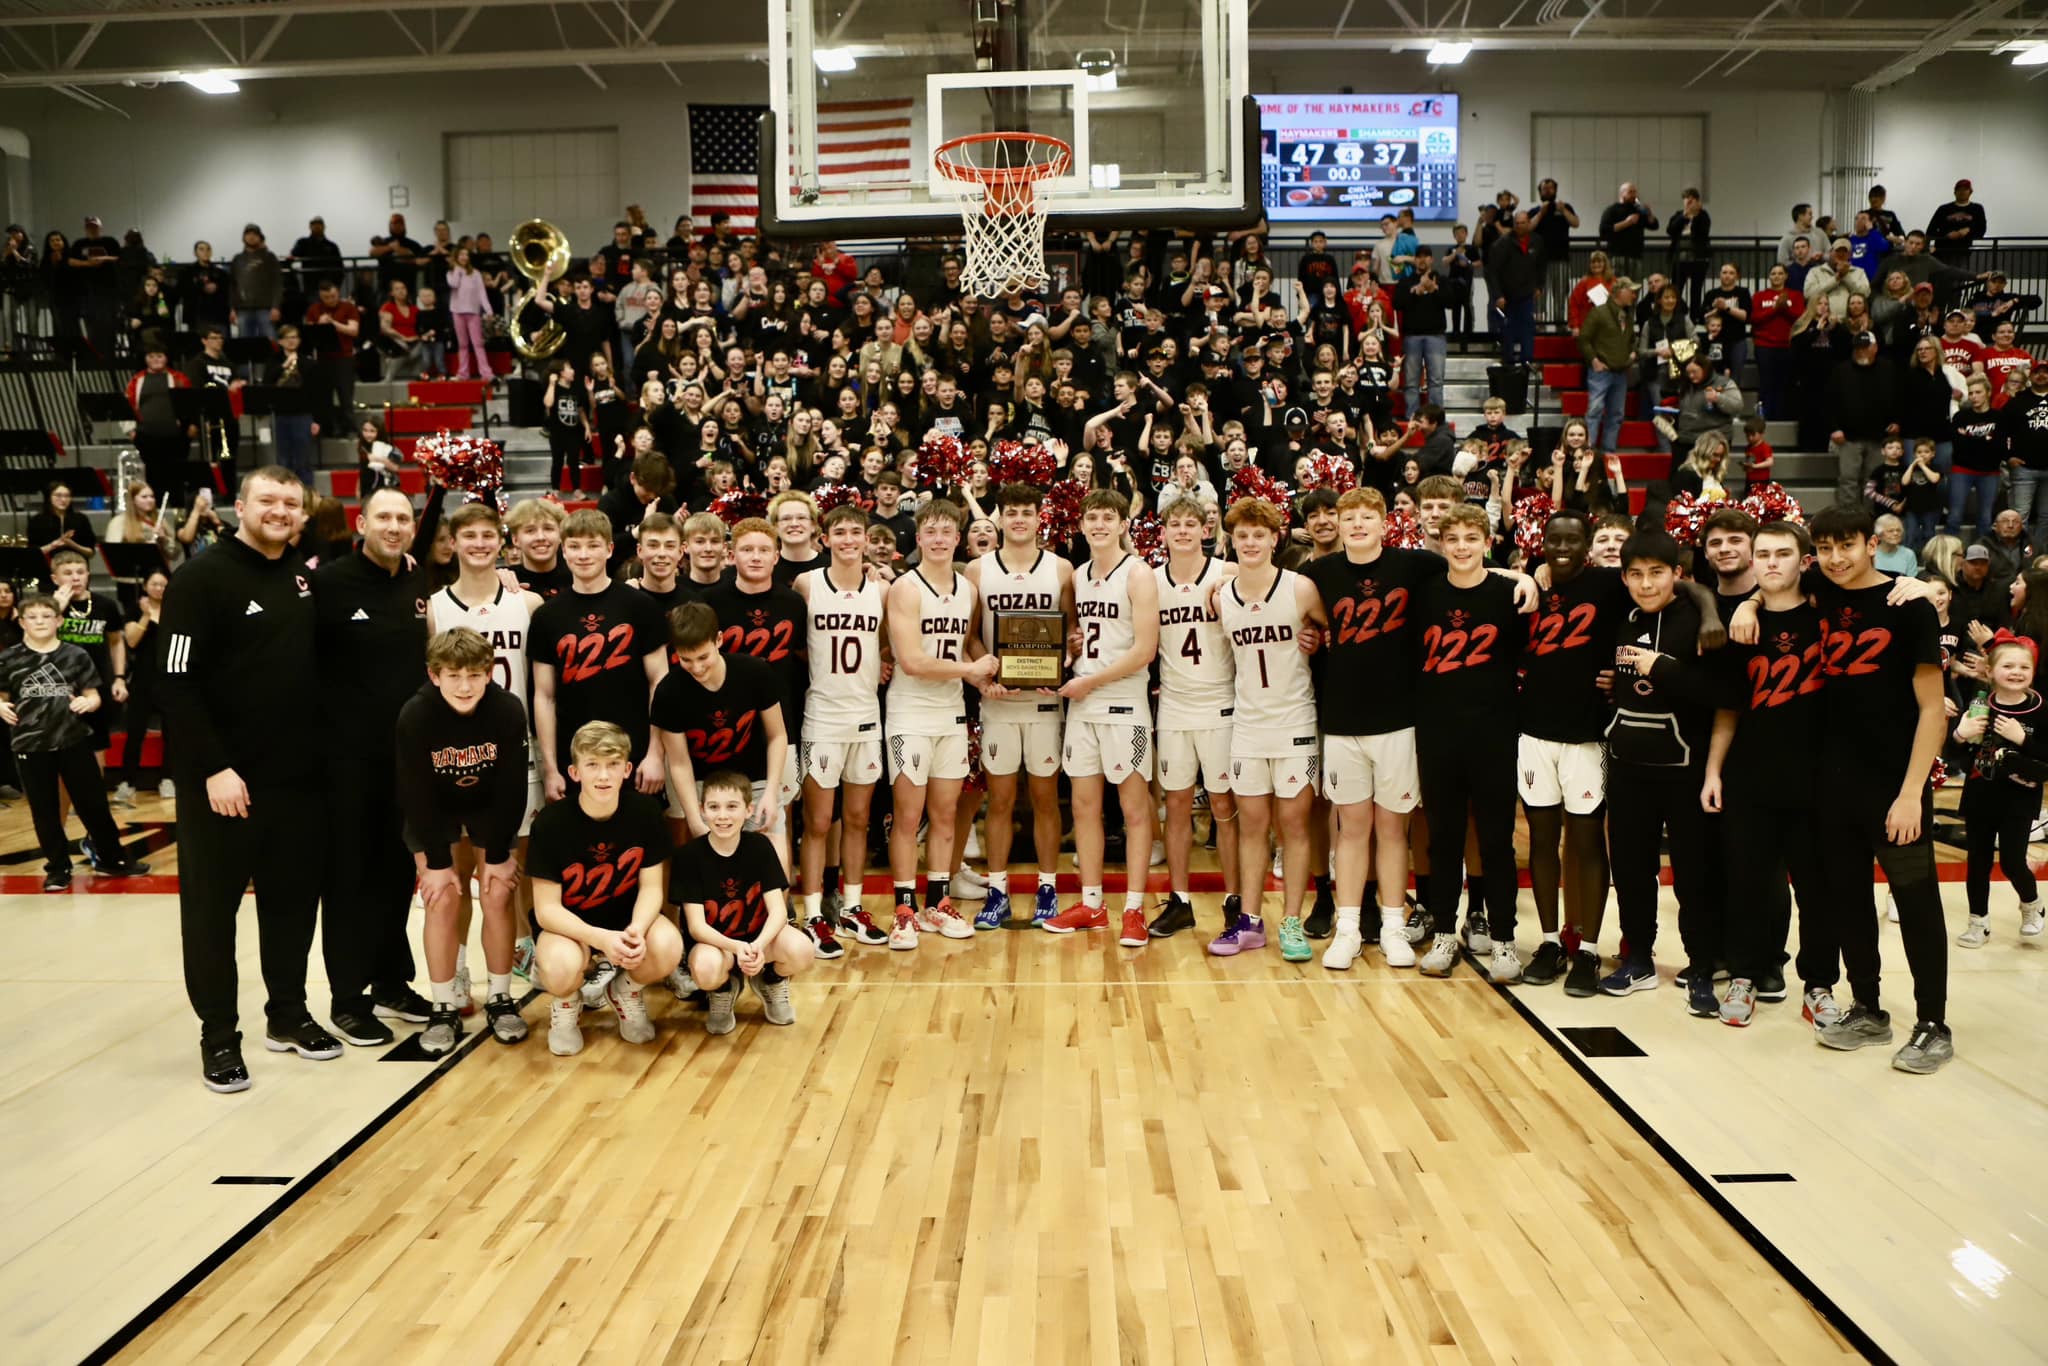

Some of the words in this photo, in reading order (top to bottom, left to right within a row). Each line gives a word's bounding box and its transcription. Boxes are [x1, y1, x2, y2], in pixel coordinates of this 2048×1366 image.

[1260, 103, 1281, 114] OME
[1287, 103, 1298, 114] OF
[1304, 103, 1325, 114] THE
[1329, 103, 1400, 114] HAYMAKERS
[1291, 143, 1325, 166] 47
[1374, 143, 1406, 166] 37
[1328, 167, 1361, 180] 00.0
[987, 593, 1052, 611] COZAD
[1076, 601, 1119, 619] COZAD
[814, 613, 878, 632] COZAD
[921, 617, 968, 635] COZAD
[1159, 606, 1218, 625] COZAD
[1333, 587, 1409, 645] 222
[1087, 623, 1100, 659] 2
[1181, 628, 1202, 665] 4
[1232, 625, 1293, 646] COZAD
[557, 622, 635, 685] 222
[831, 636, 862, 674] 10
[936, 639, 958, 662] 15
[1423, 623, 1498, 674] 222
[1257, 649, 1269, 688] 1
[19, 684, 73, 698] adidas
[562, 847, 645, 910] 222
